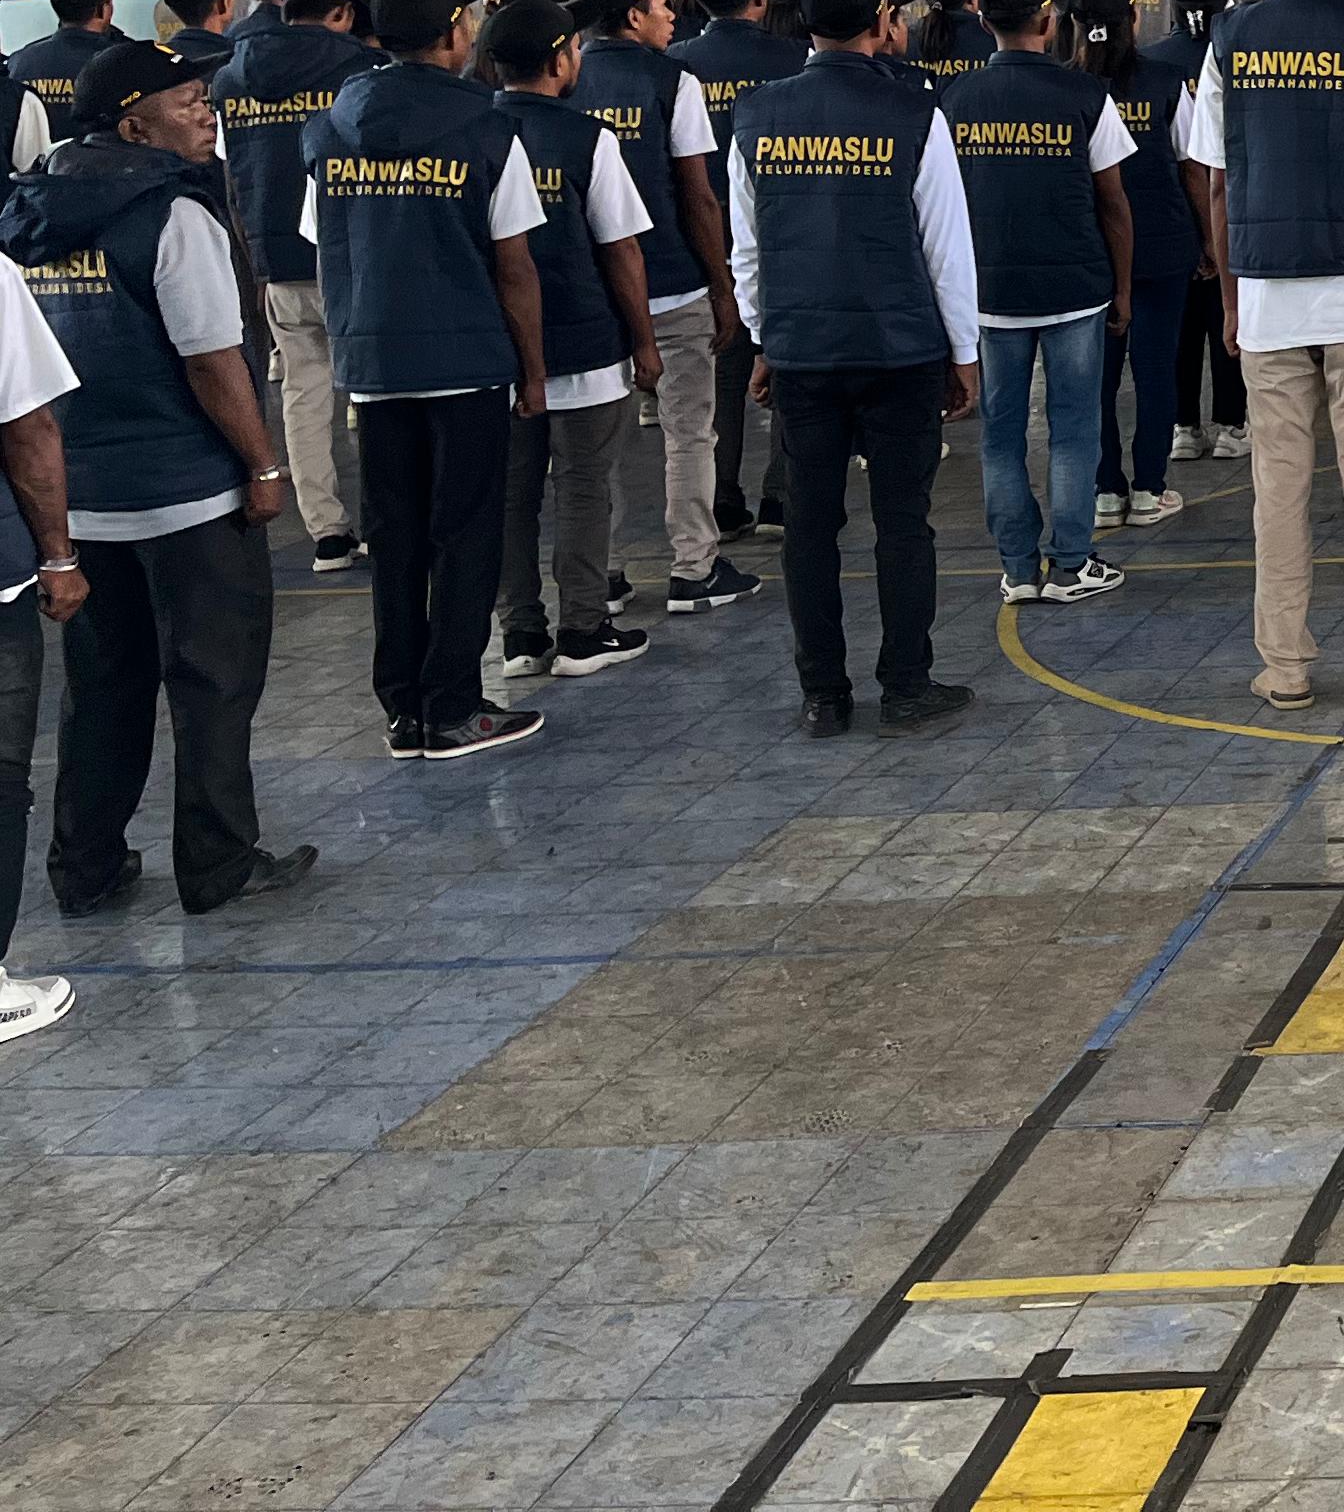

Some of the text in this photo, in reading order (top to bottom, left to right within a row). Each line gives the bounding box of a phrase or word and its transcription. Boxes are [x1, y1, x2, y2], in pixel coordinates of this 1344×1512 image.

[956, 123, 1072, 145] PANWASLU
[756, 137, 894, 163] PANWASLU
[956, 147, 1072, 157] KELURAHAN/DESA
[326, 157, 469, 185] PANWASLU
[755, 165, 892, 176] KELURAHAN/DESA
[327, 185, 463, 199] KELURAHAN/DESA
